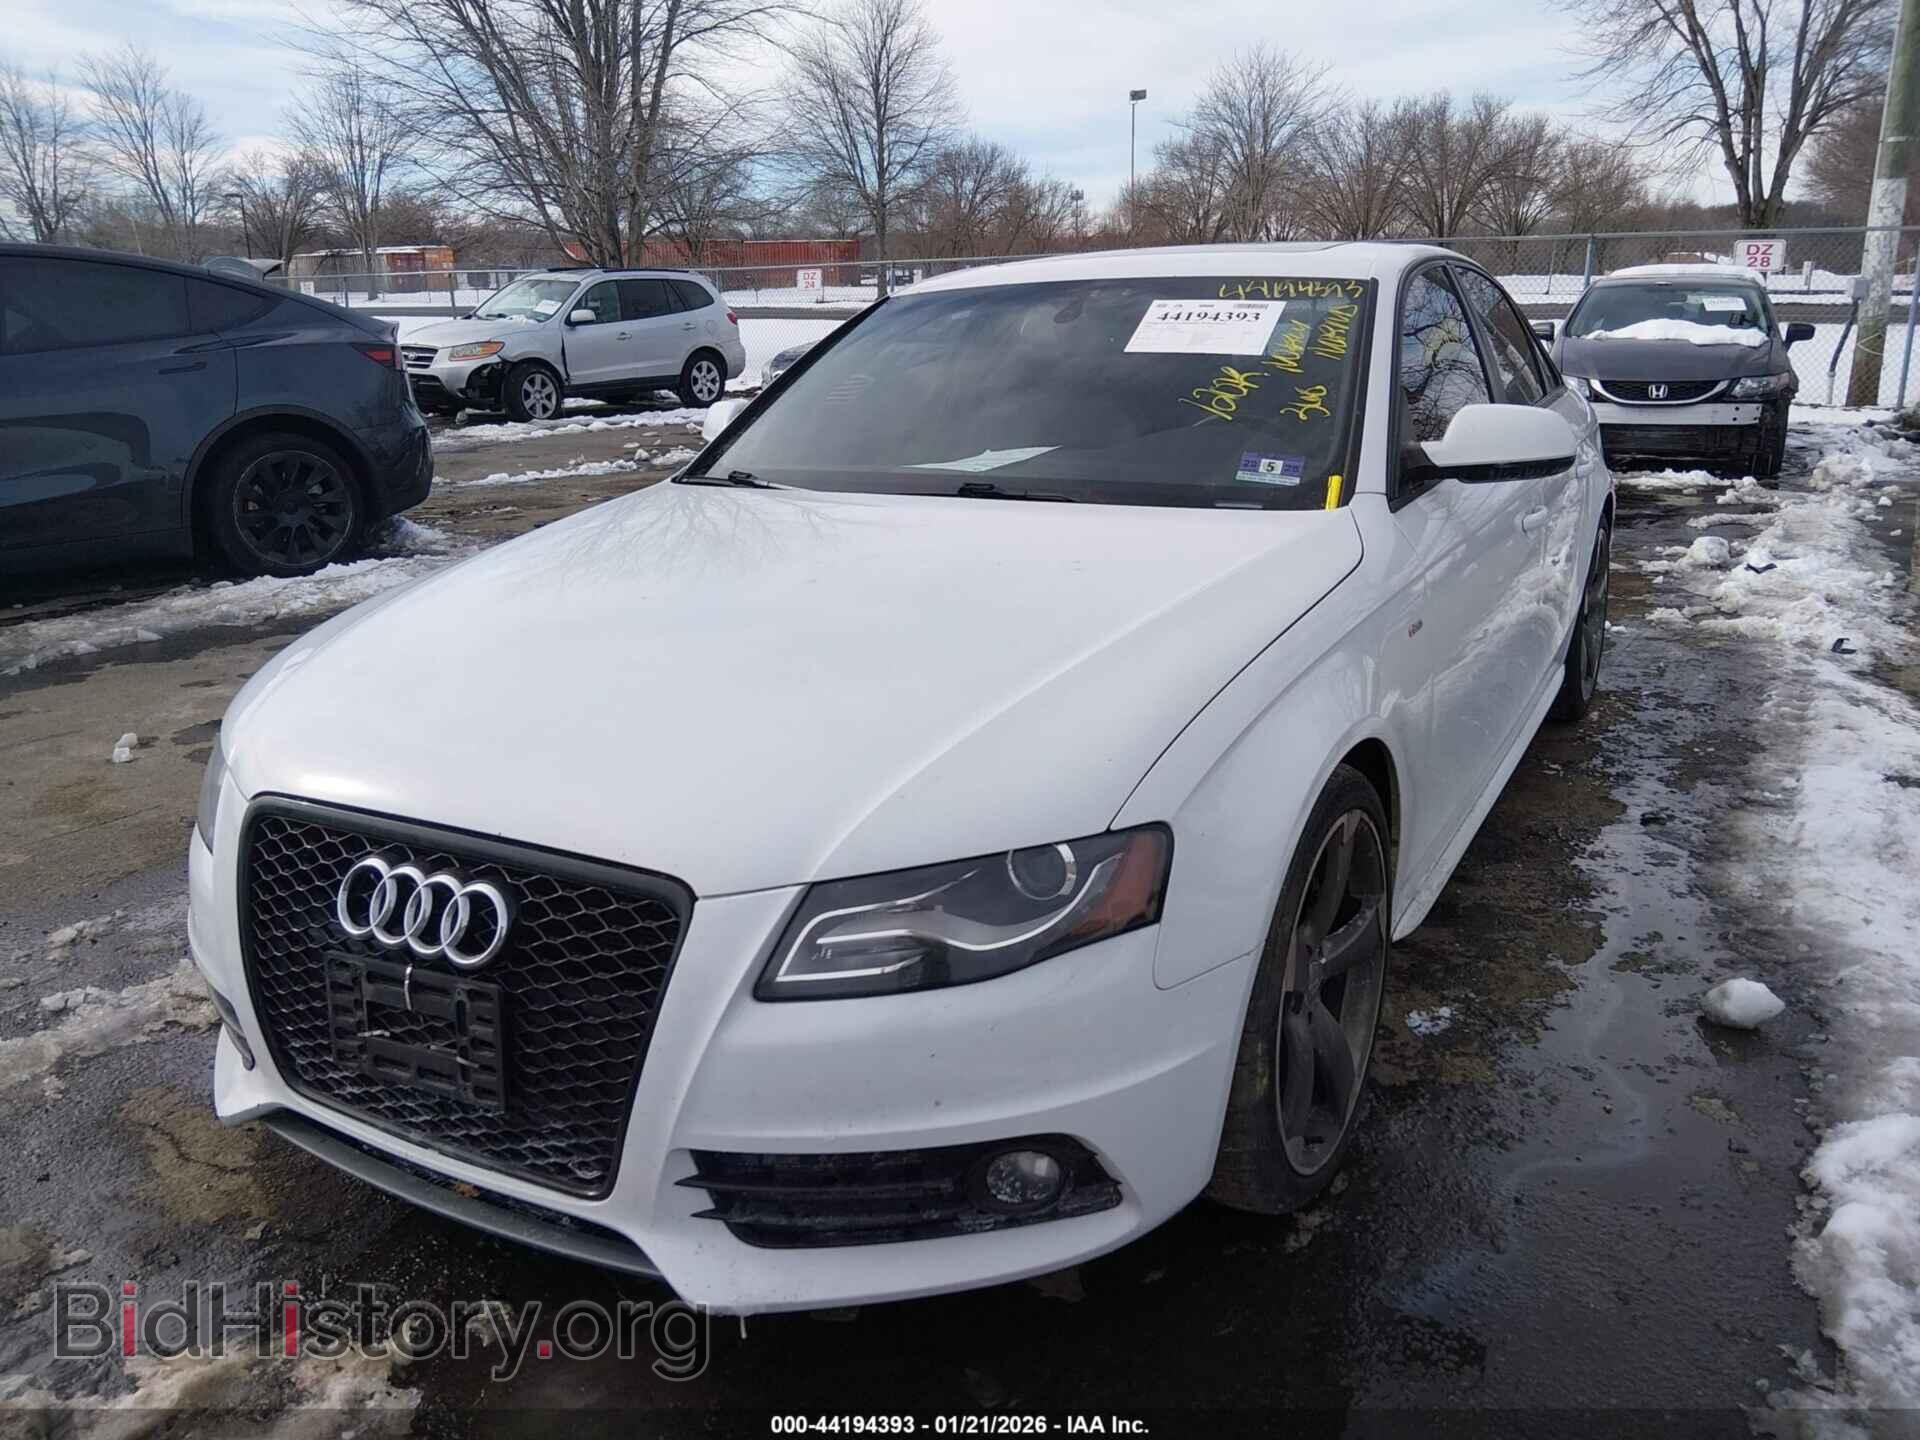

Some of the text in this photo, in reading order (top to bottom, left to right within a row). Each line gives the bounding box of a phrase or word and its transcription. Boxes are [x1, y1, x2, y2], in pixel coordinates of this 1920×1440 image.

[1746, 244, 1774, 256] DZ
[1747, 256, 1770, 267] 28
[803, 271, 817, 280] DZ
[1156, 311, 1261, 321] 44194393
[1265, 461, 1276, 473] 5
